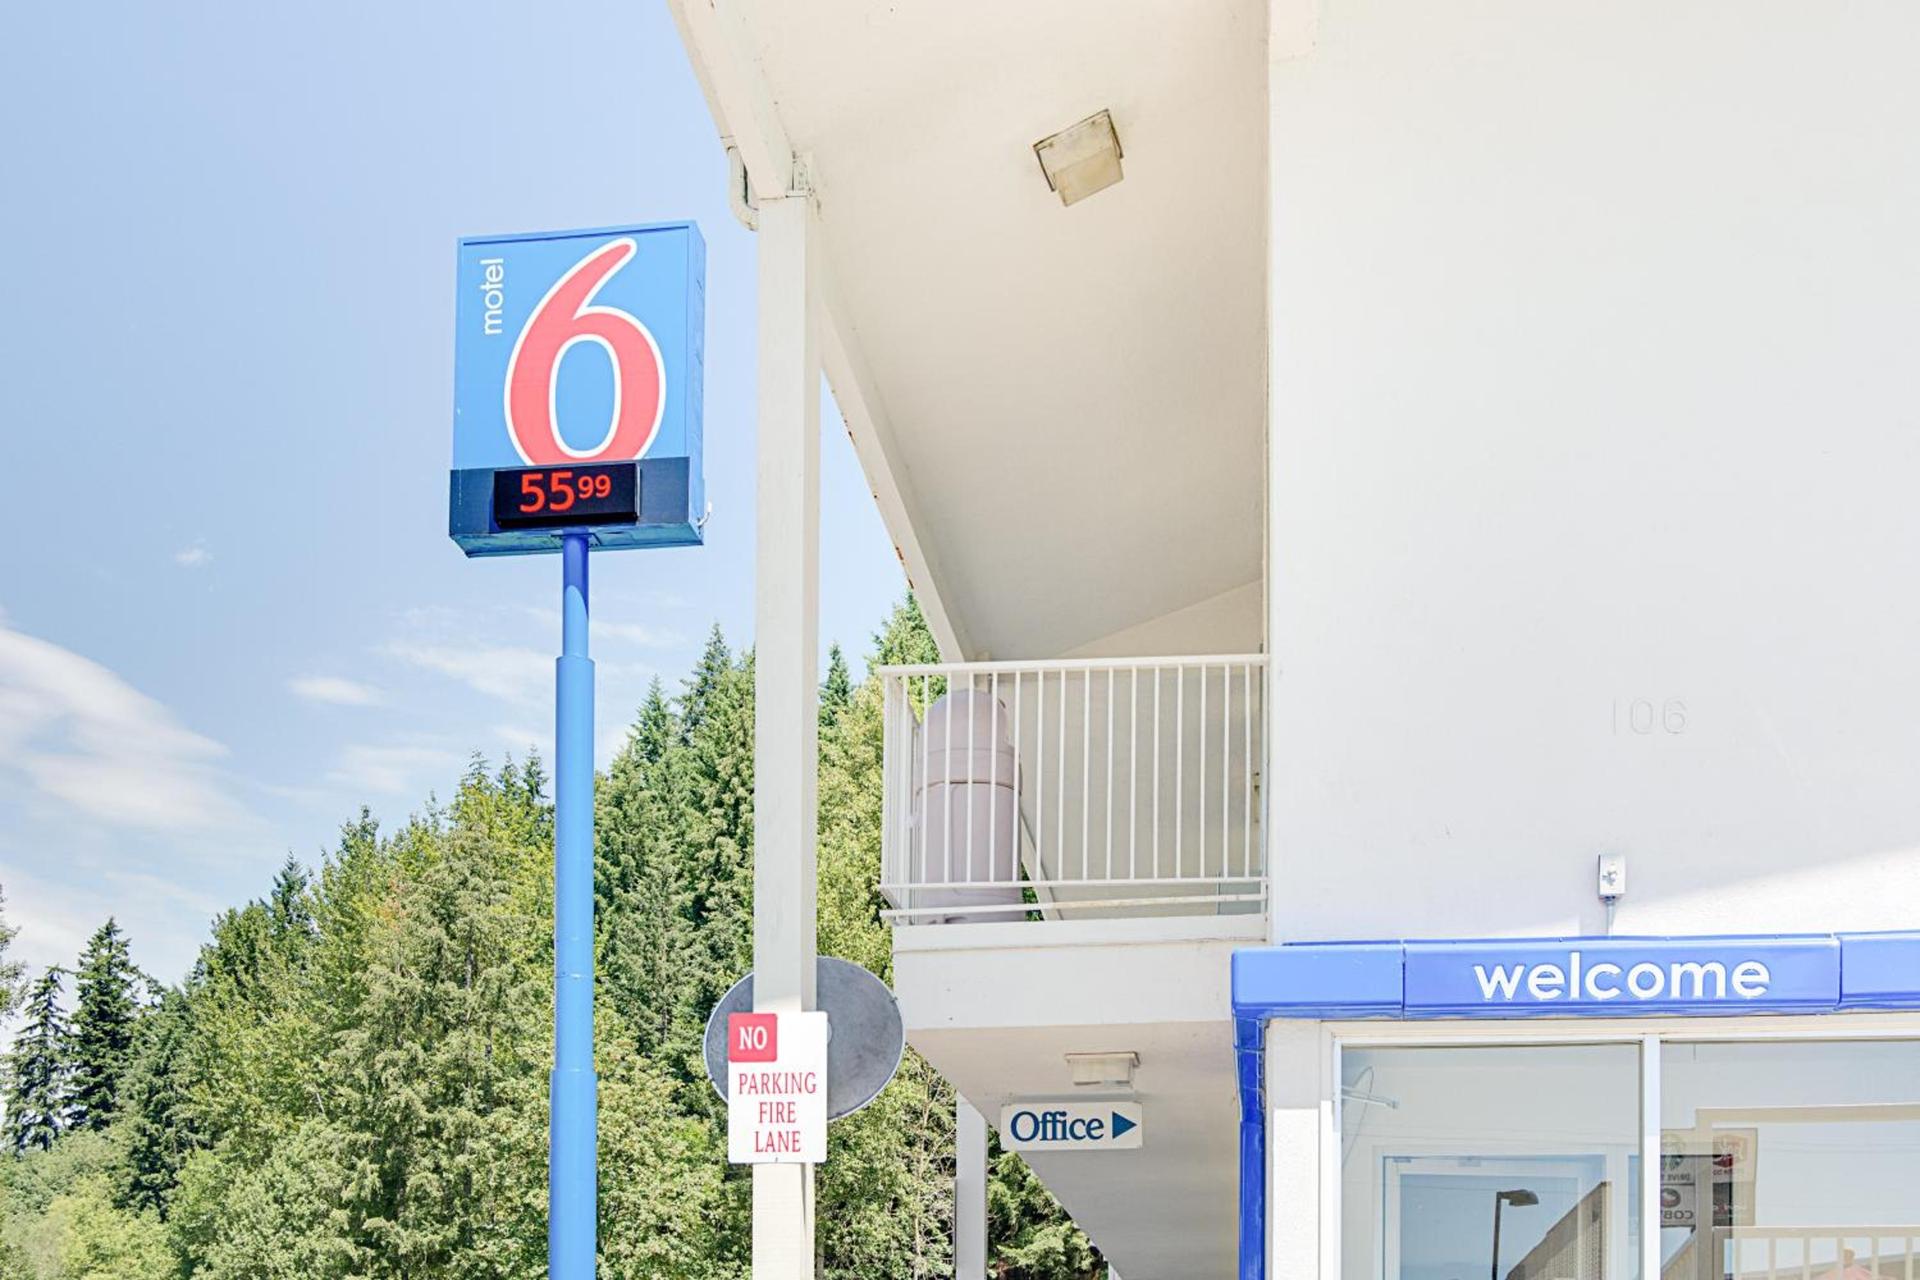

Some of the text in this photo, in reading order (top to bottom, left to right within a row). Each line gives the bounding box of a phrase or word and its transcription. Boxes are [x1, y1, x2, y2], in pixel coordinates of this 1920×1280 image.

[480, 258, 503, 335] motel
[503, 237, 666, 466] 6
[1474, 952, 1770, 1000] welcome
[739, 1026, 768, 1050] NO
[738, 1071, 817, 1095] PARKING
[758, 1101, 797, 1124] FIRE
[1010, 1111, 1105, 1141] Office
[754, 1130, 802, 1153] LANE
